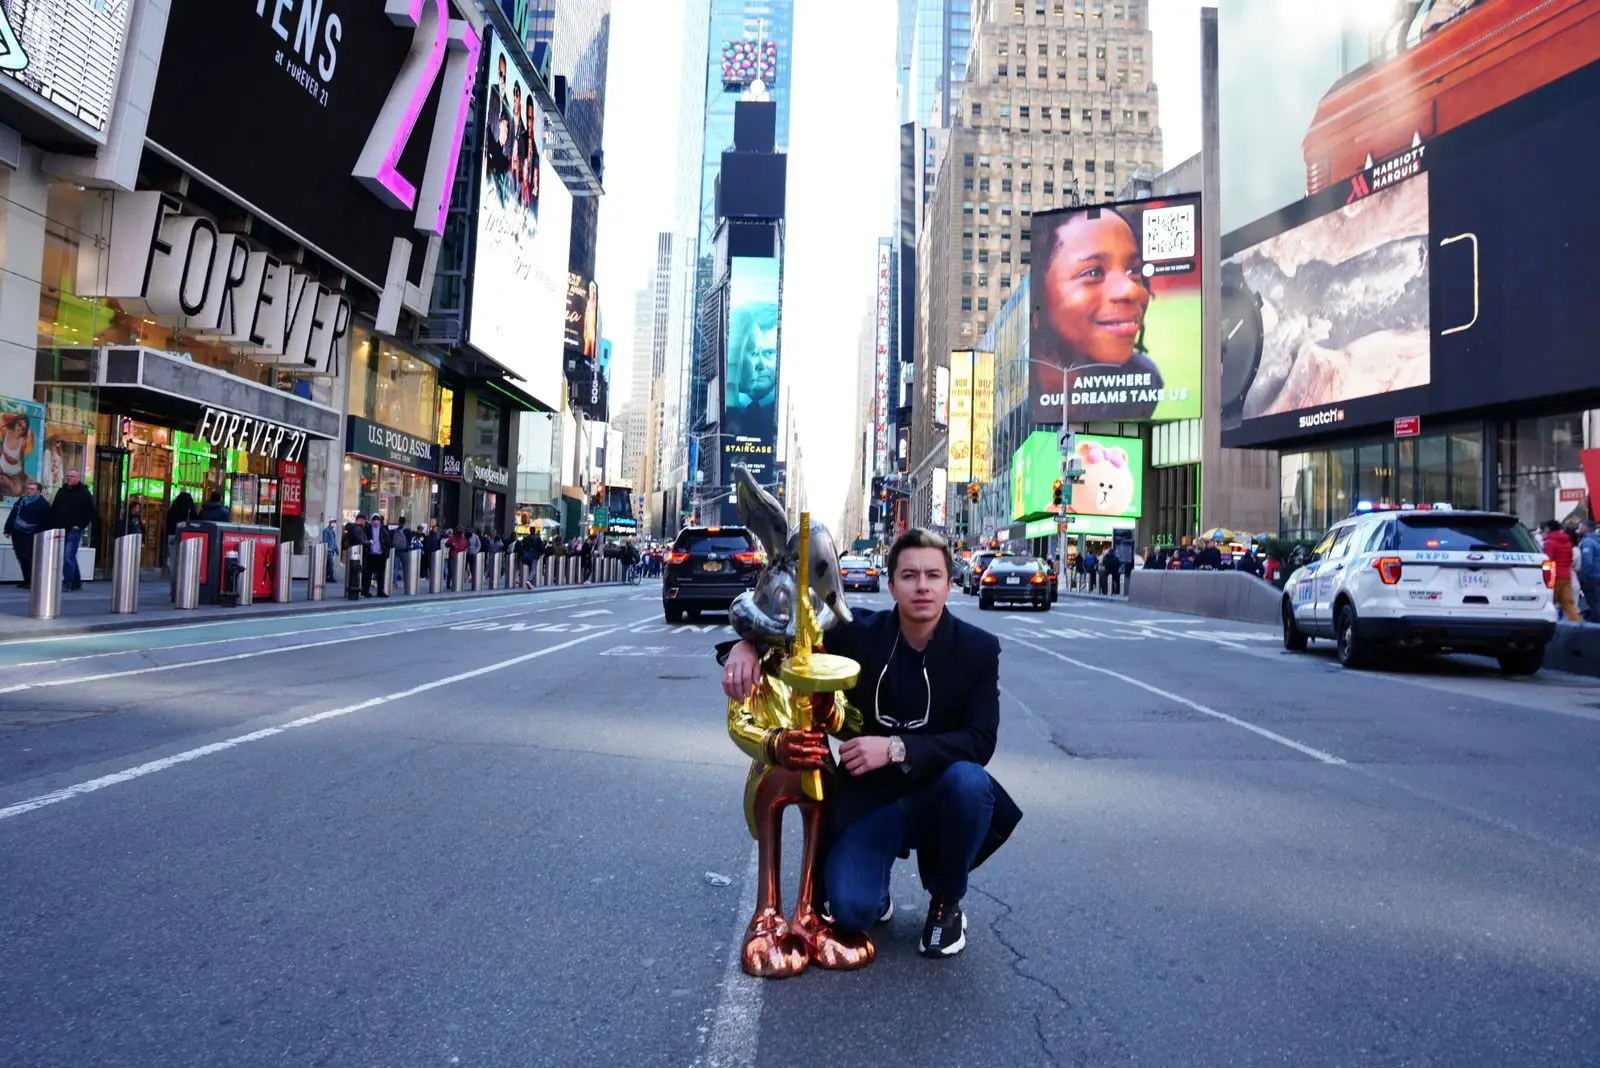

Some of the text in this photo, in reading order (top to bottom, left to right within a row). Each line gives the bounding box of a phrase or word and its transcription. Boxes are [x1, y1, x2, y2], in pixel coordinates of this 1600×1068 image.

[286, 60, 319, 99] FOREVER
[319, 88, 329, 108] 21
[1373, 145, 1425, 178] MARRIOTT
[1373, 161, 1419, 190] MARQUIS
[141, 187, 351, 378] FOREVER
[1073, 373, 1151, 389] ANYWHERE
[1071, 391, 1127, 405] DREAMS
[1130, 388, 1165, 402] TAKE
[1169, 387, 1188, 400] US
[1299, 408, 1338, 428] swatch
[198, 407, 307, 463] FOREVER 21
[368, 424, 432, 460] U.S. POLO ASSN.
[725, 445, 772, 453] STAIRCASE
[1416, 552, 1535, 562] NYPD POLICE
